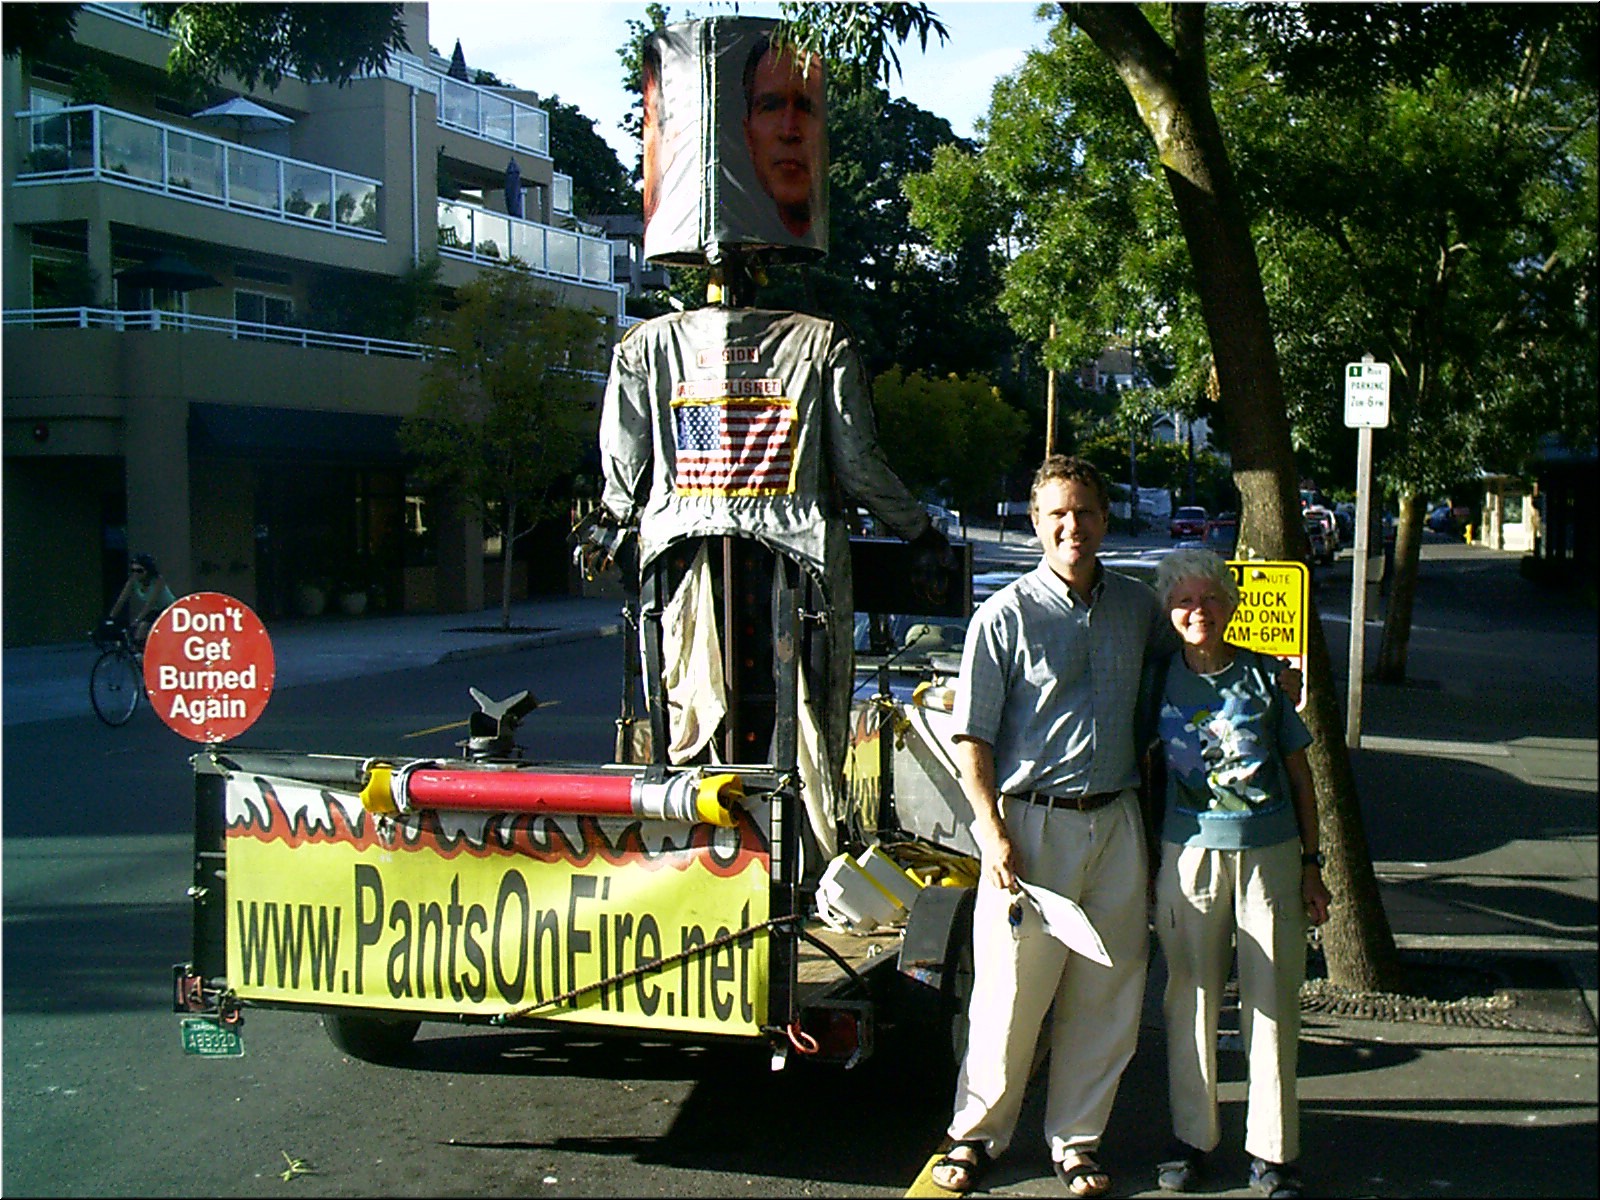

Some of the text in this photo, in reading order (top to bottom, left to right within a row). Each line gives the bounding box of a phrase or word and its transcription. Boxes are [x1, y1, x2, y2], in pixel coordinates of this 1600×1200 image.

[700, 347, 757, 365] SION
[678, 381, 781, 396] ACPLISHED
[1350, 381, 1385, 391] PARKING
[1251, 573, 1291, 584] NUTE
[1238, 591, 1288, 607] RUCK
[172, 607, 243, 632] Don't
[1234, 609, 1296, 624] AD ONLY
[1226, 626, 1295, 642] AM-6PM
[184, 636, 231, 661] Get
[159, 664, 256, 690] Burned
[169, 693, 247, 724] Again
[237, 863, 754, 1024] www.PantsOnFire.net
